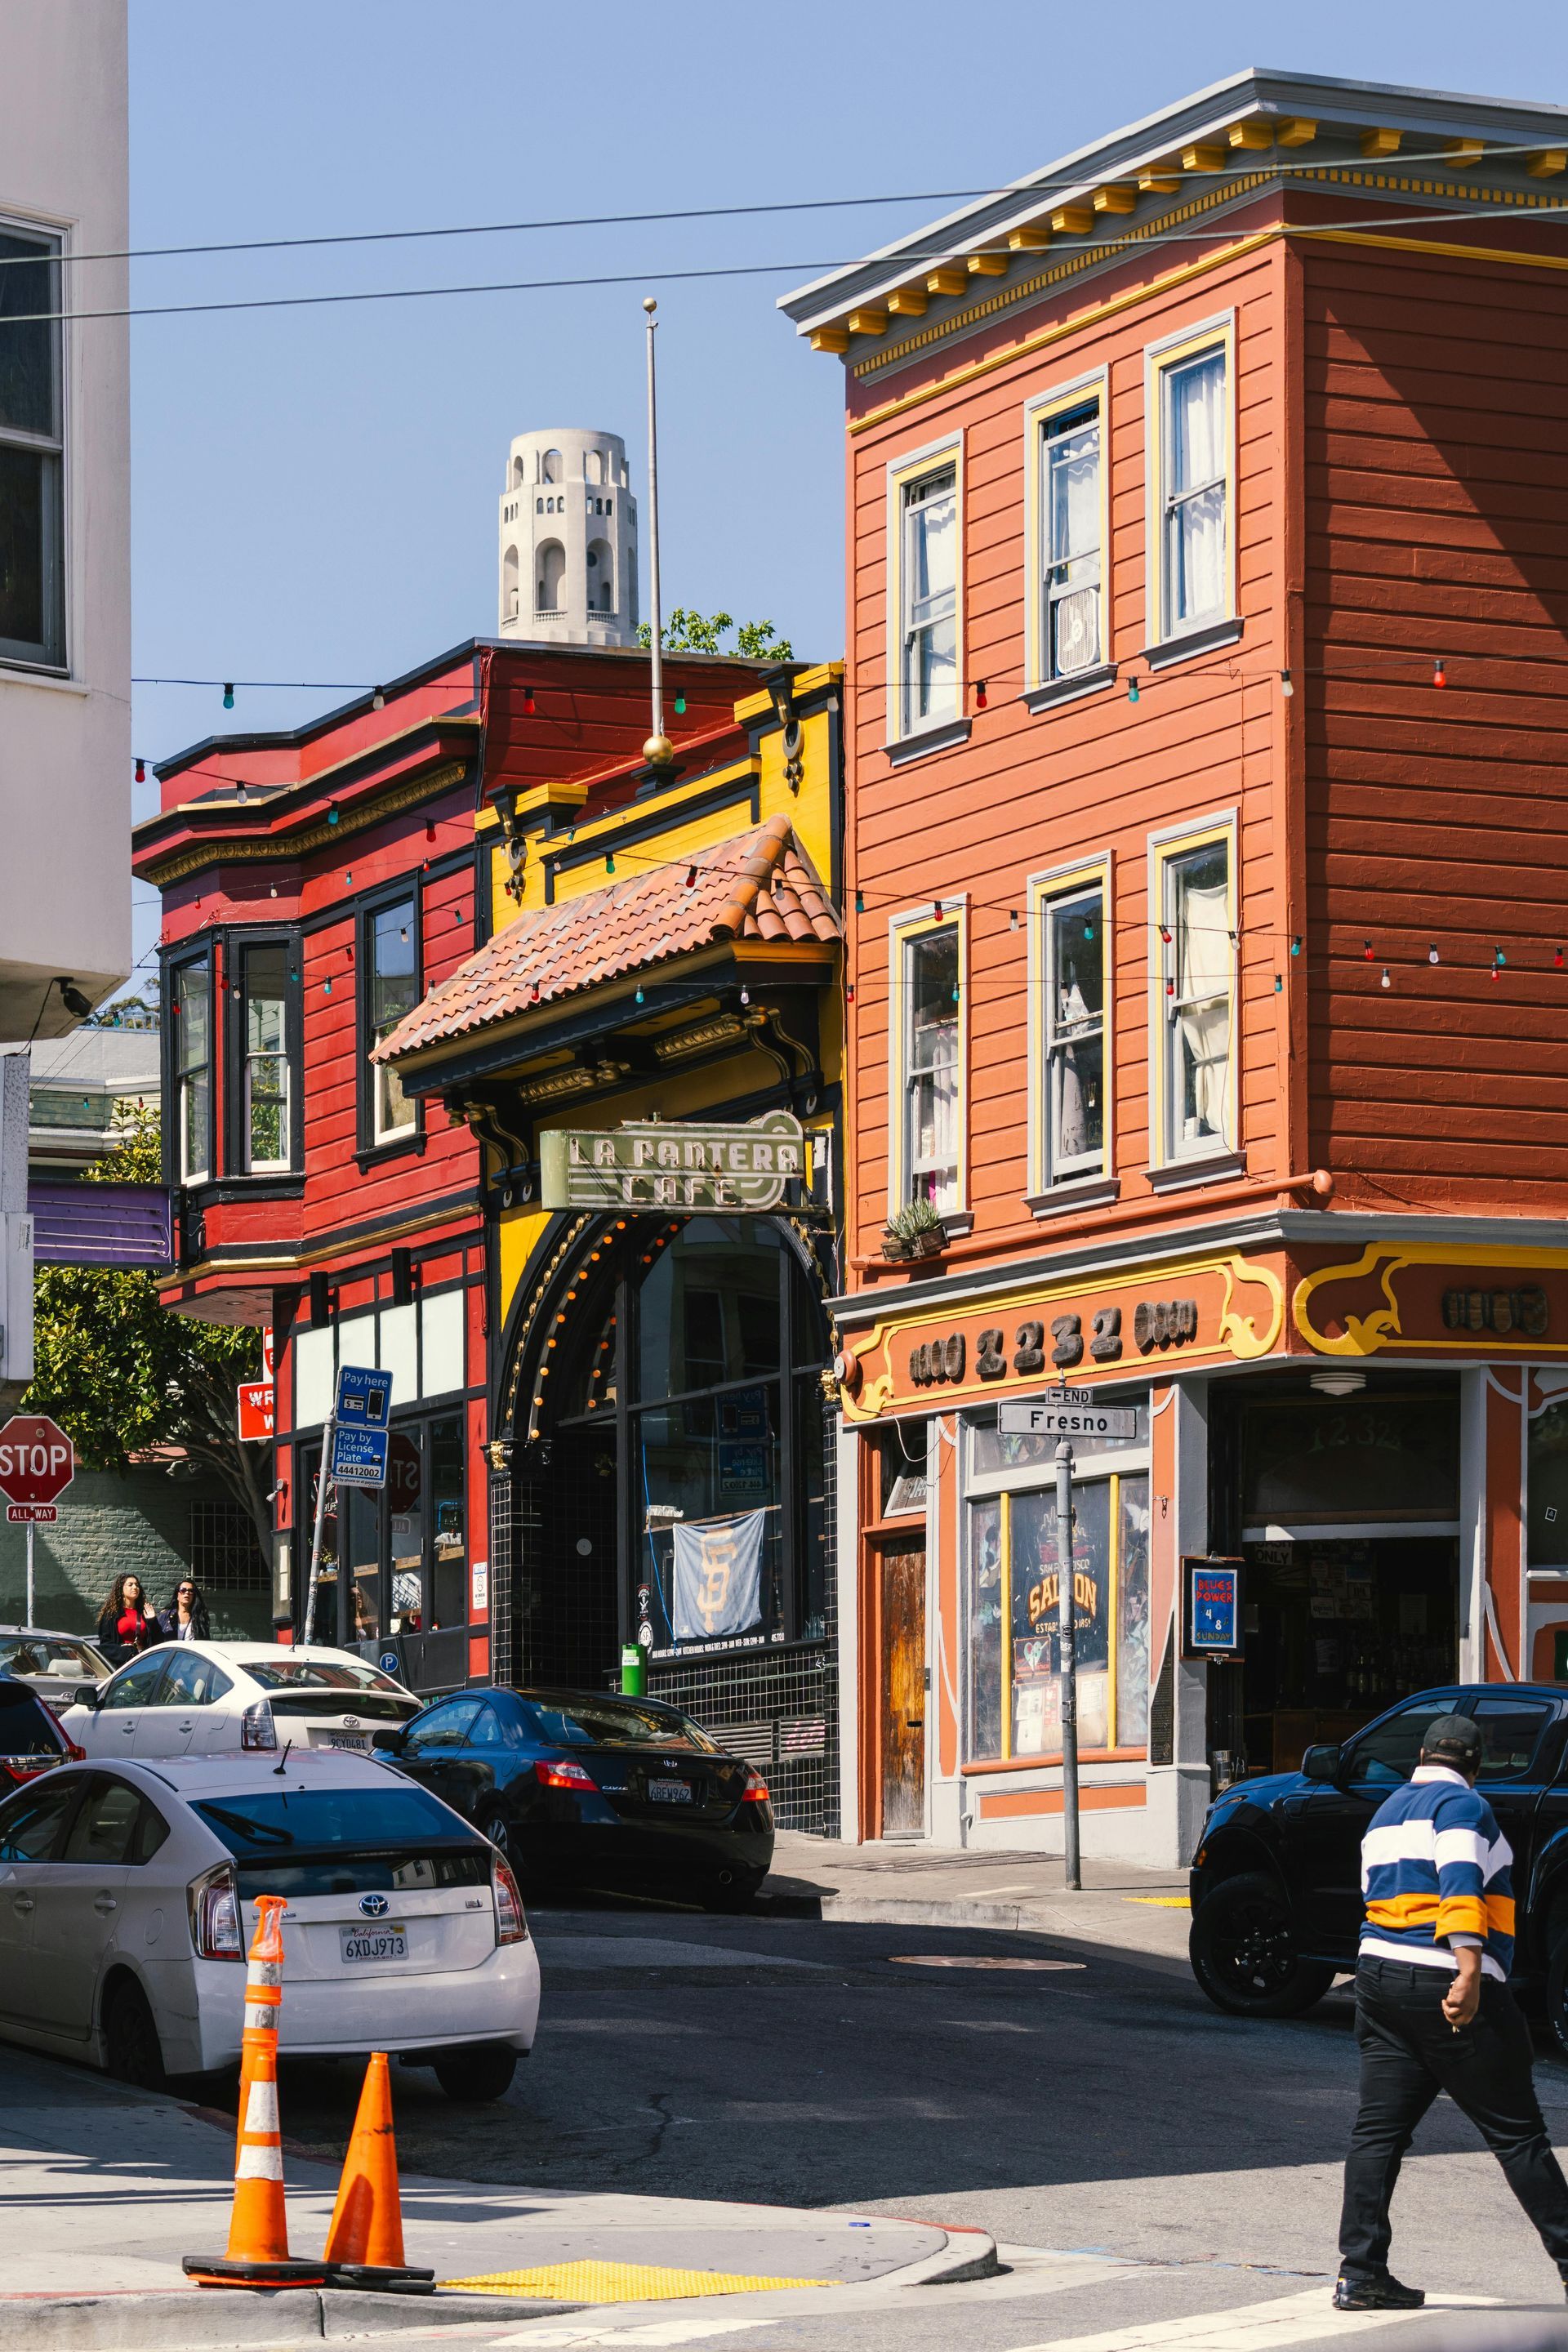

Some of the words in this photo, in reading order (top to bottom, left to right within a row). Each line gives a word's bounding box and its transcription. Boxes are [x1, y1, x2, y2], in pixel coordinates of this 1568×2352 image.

[569, 1138, 616, 1165] LA
[633, 1139, 798, 1172] PANTERA
[621, 1176, 737, 1205] CAFE
[344, 1372, 363, 1387] Pay
[364, 1374, 388, 1388] here
[1063, 1389, 1089, 1403] END
[1030, 1410, 1108, 1432] Fresno
[338, 1430, 357, 1444] Pay
[359, 1432, 372, 1444] by
[338, 1441, 374, 1454] License
[0, 1445, 67, 1477] STOP
[336, 1451, 362, 1463] Plate
[338, 1466, 380, 1477] 44412002
[11, 1508, 28, 1520] ALL
[34, 1508, 54, 1520] WAY
[1256, 1549, 1290, 1564] ONLY
[1197, 1579, 1232, 1591] BLUES
[1028, 1573, 1098, 1626] SALON
[1196, 1590, 1233, 1603] POWER
[1196, 1632, 1232, 1642] SUNDAY
[331, 1738, 367, 1749] 9CYD481
[353, 1928, 394, 1939] California
[346, 1938, 404, 1958] 6XDJ973
